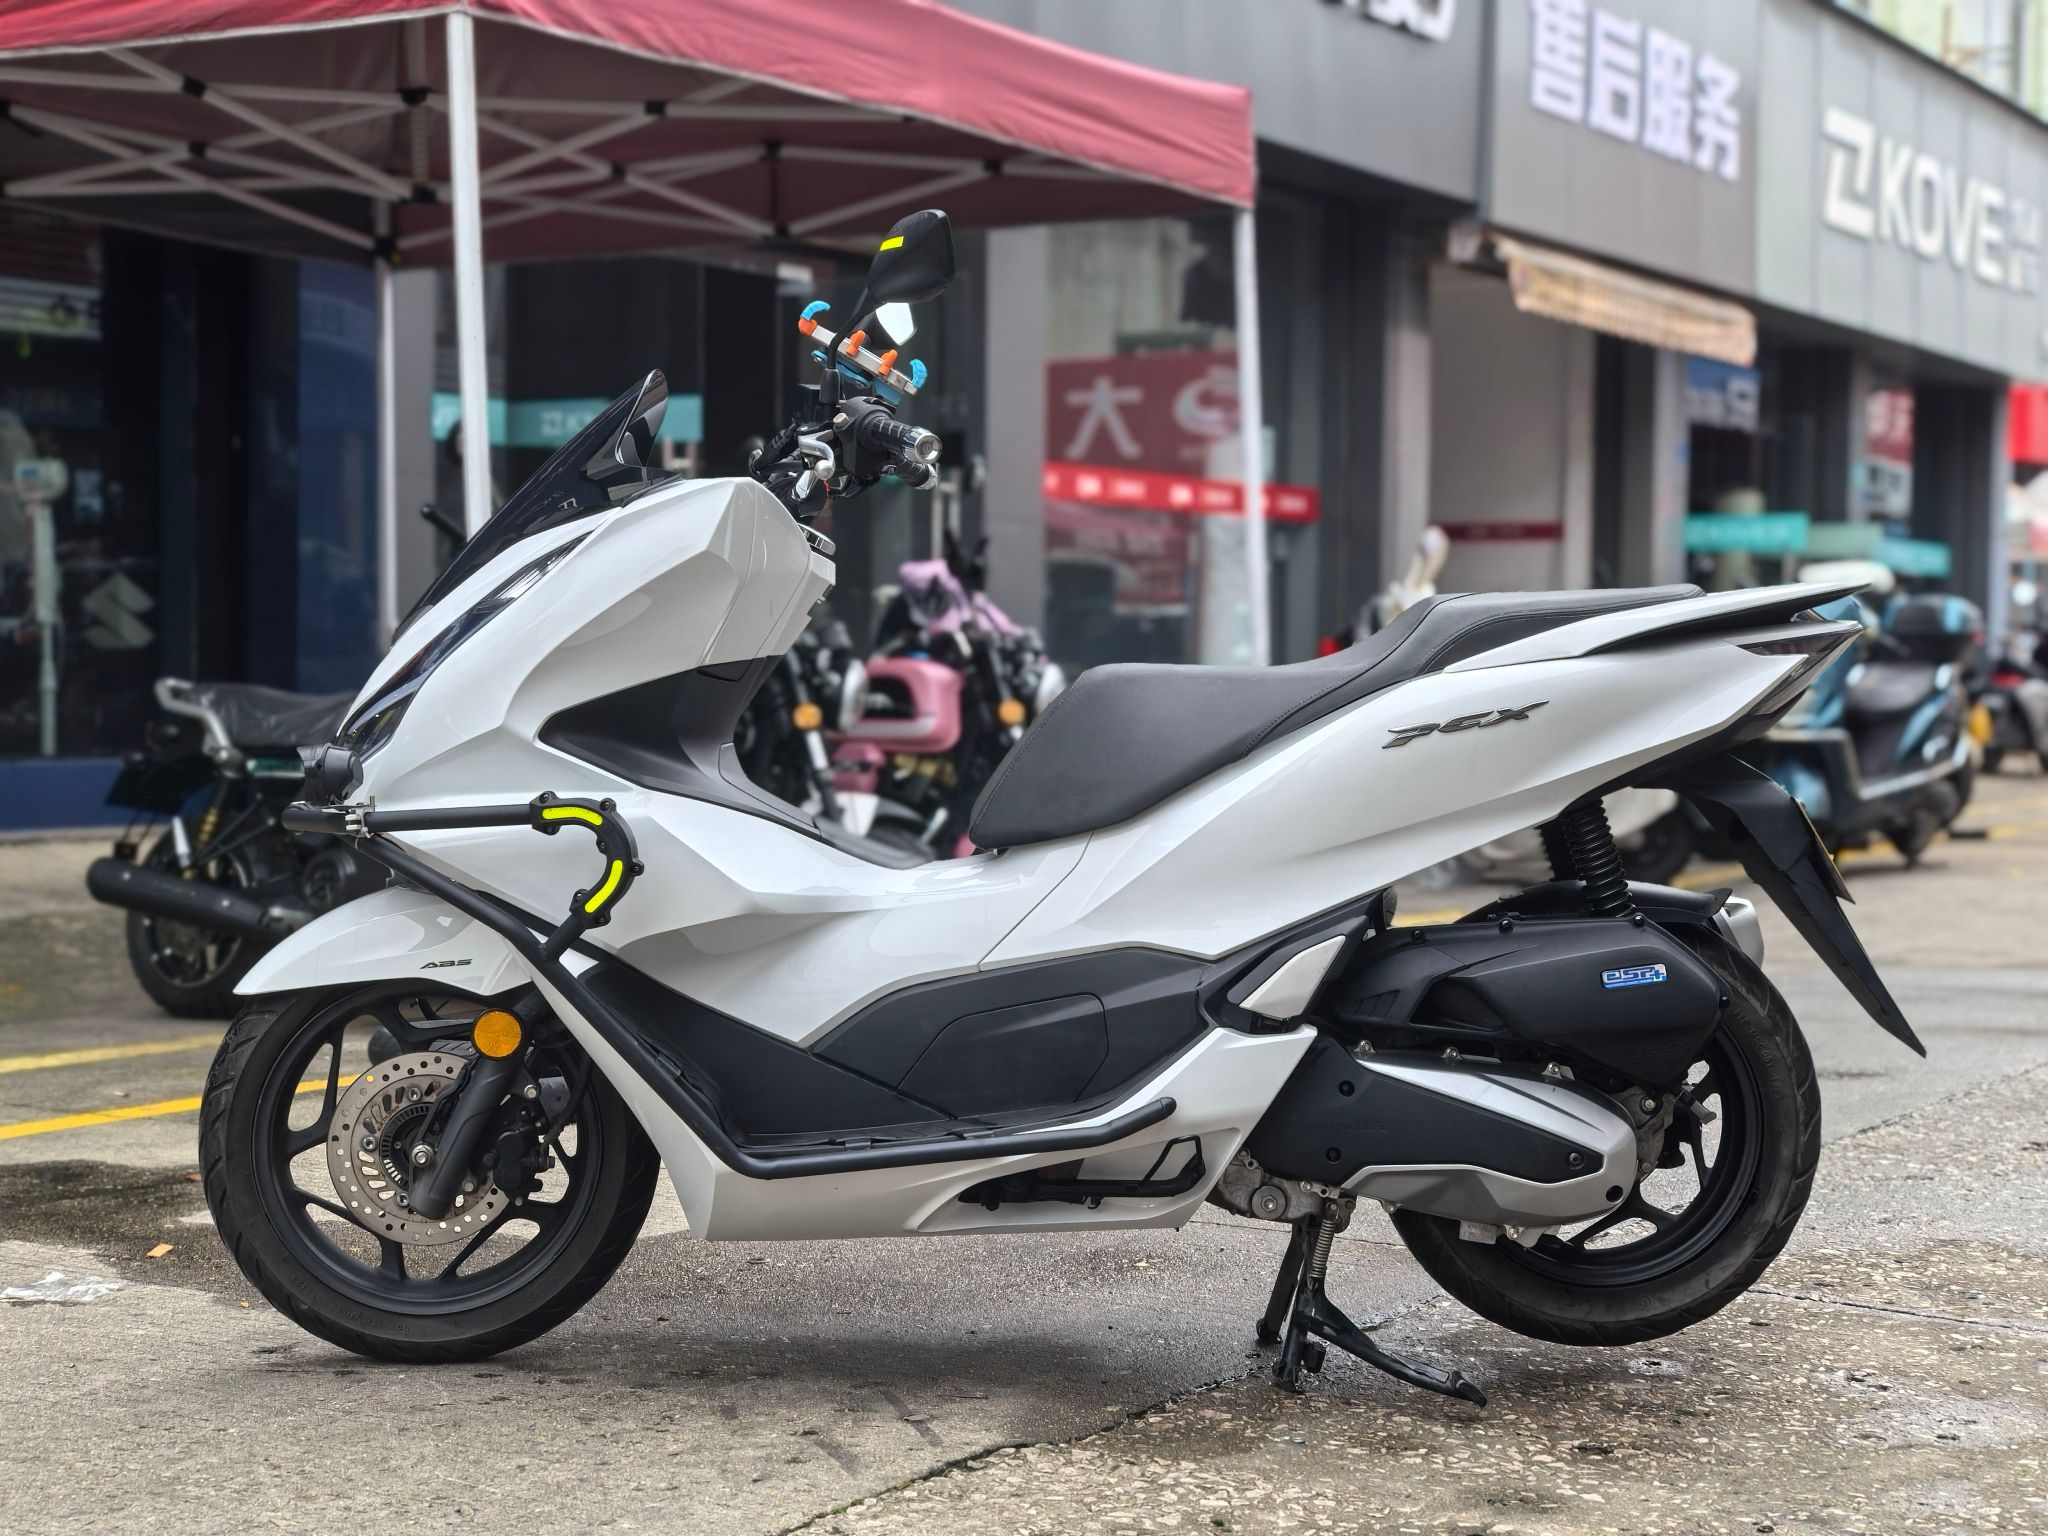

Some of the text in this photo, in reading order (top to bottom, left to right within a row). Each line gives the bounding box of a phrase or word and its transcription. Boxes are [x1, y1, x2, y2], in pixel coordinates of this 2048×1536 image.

[1530, 0, 1741, 181] 售后服务
[1877, 134, 2006, 286] KOVE
[1064, 374, 1144, 461] 大
[1382, 699, 1550, 750] PCX
[419, 958, 473, 970] ABS
